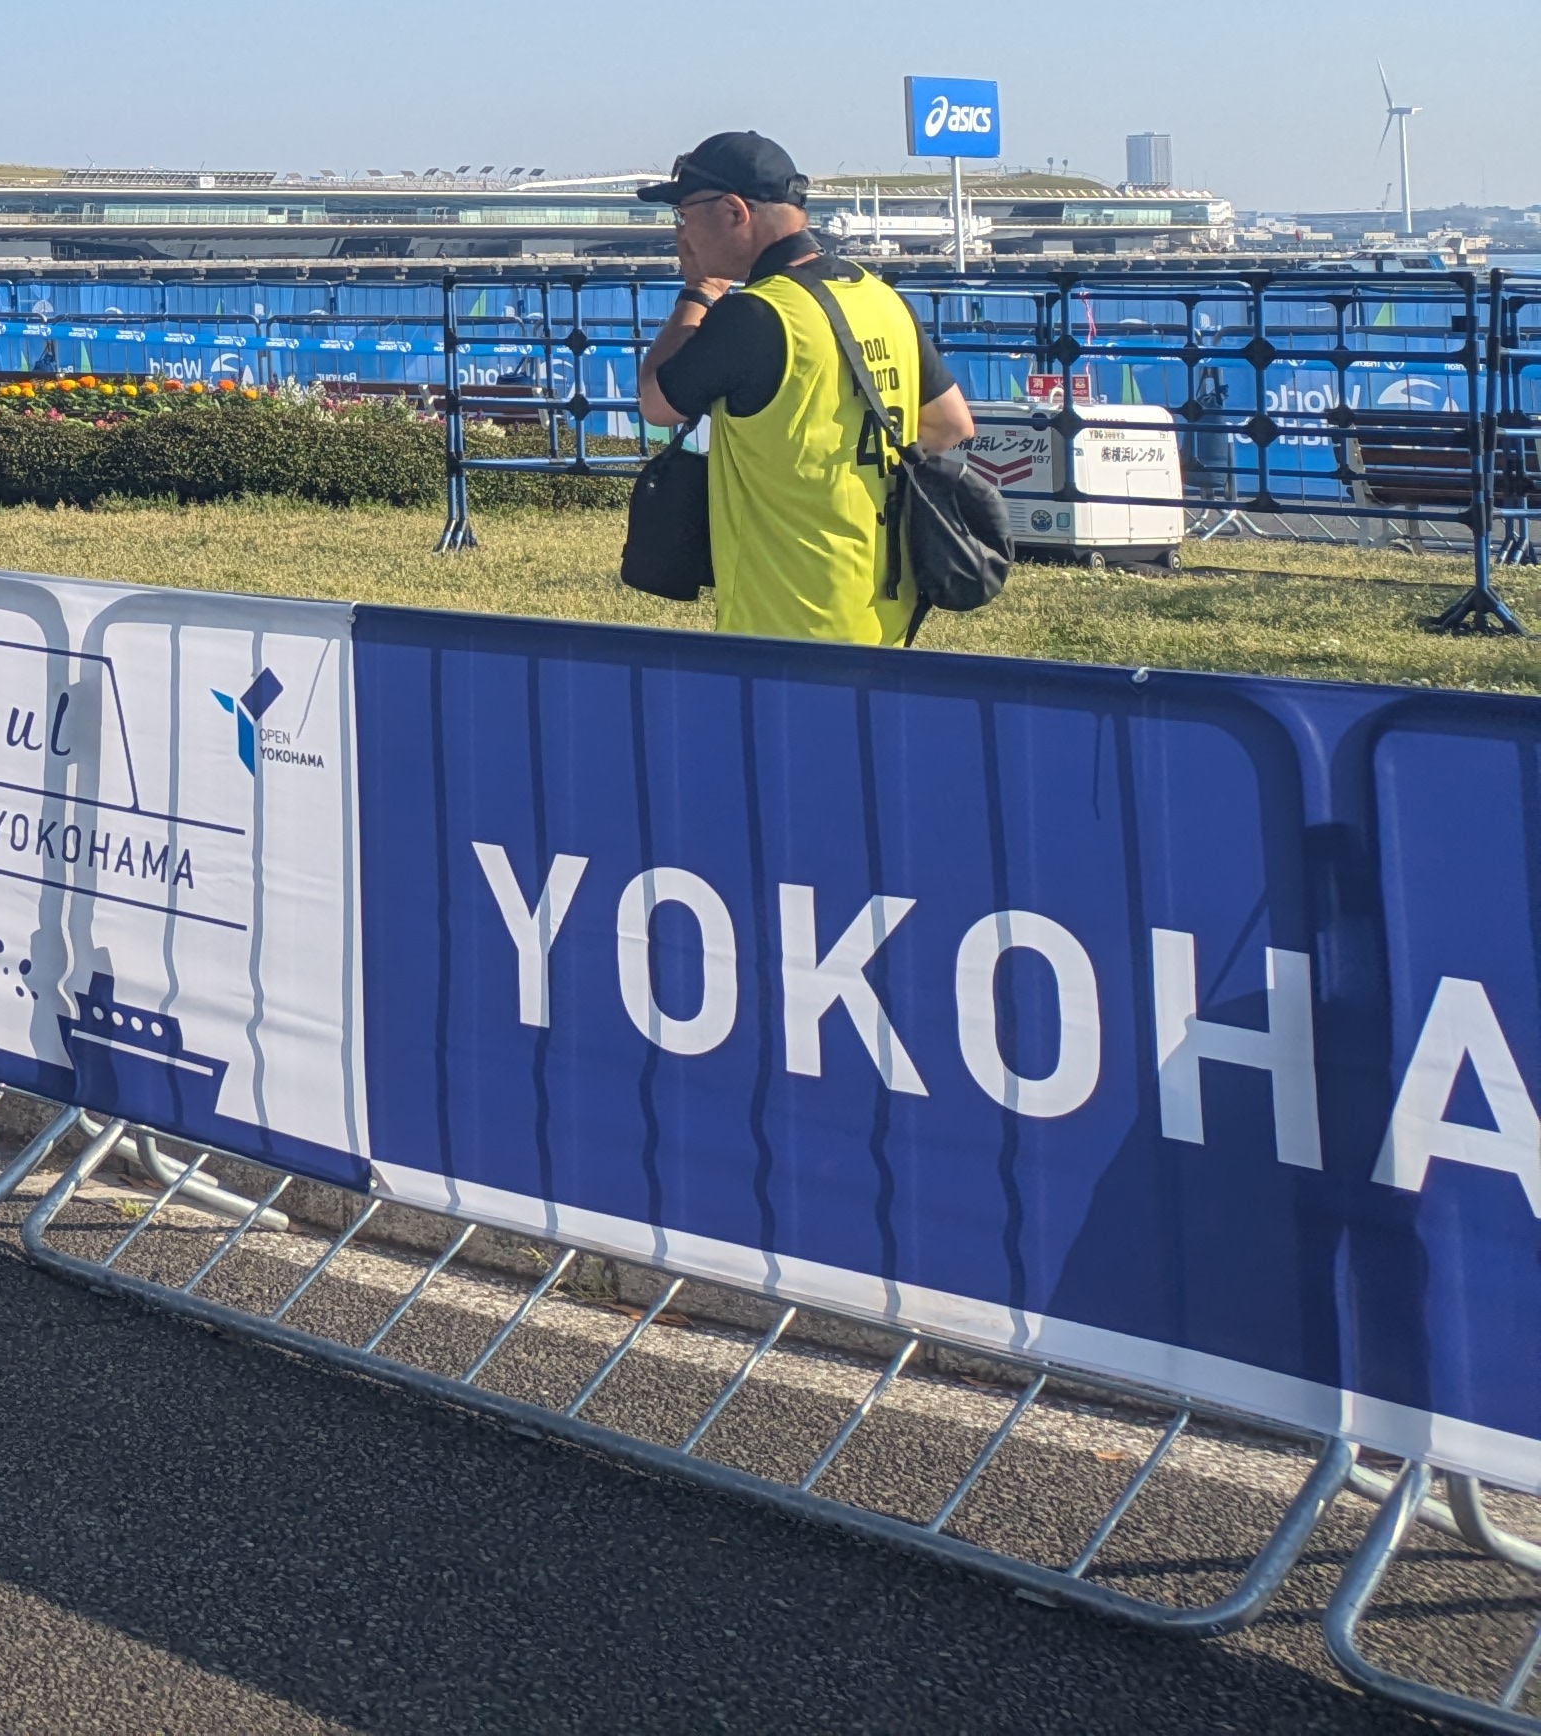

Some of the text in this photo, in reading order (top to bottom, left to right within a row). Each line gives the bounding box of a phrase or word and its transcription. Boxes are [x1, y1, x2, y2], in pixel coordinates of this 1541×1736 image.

[948, 105, 992, 133] asics
[949, 435, 1049, 454] 横浜レンタル
[1032, 455, 1051, 464] 197
[259, 728, 291, 745] OPEN
[259, 746, 325, 769] YOKOHAMA
[471, 839, 1541, 1220] YOKOHA
